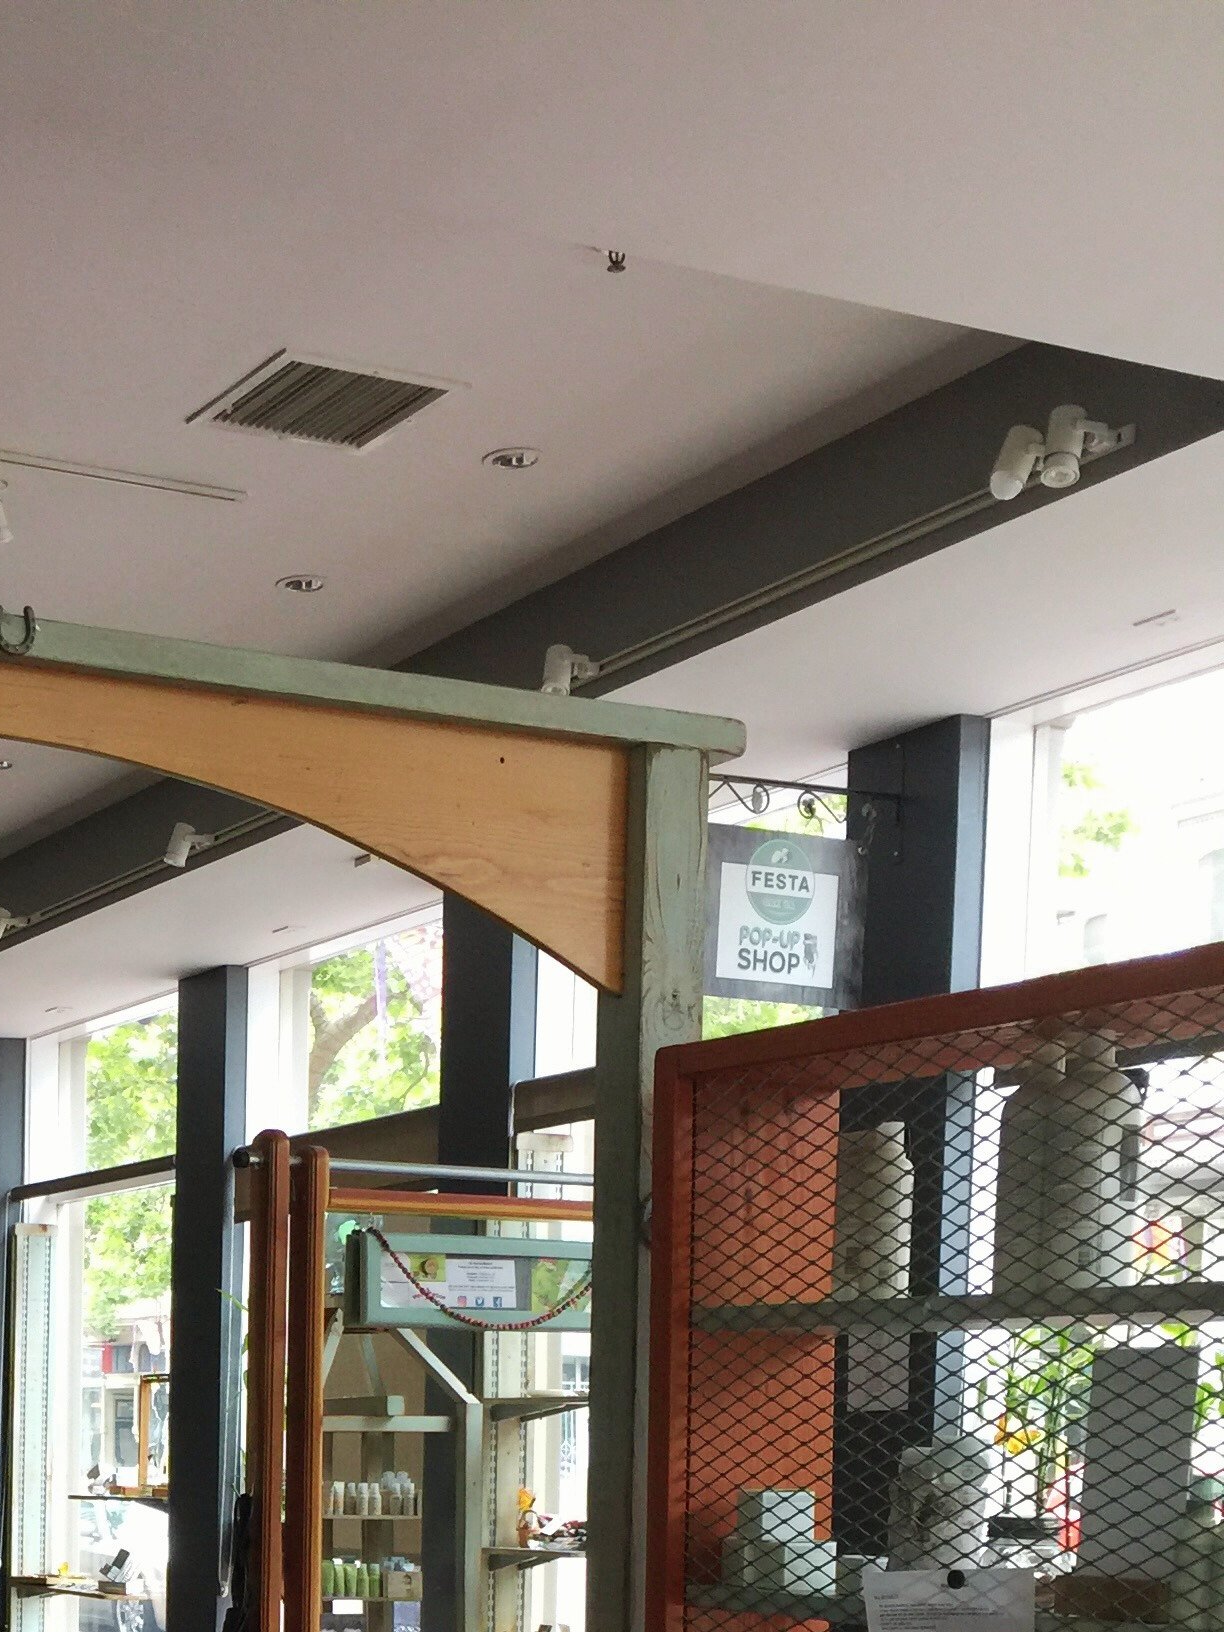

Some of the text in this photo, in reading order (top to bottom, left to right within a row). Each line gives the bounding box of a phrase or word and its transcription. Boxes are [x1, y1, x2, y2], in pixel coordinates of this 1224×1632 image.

[751, 870, 810, 893] FESTA
[738, 925, 801, 950] POP-UP
[737, 948, 800, 974] SHOP
